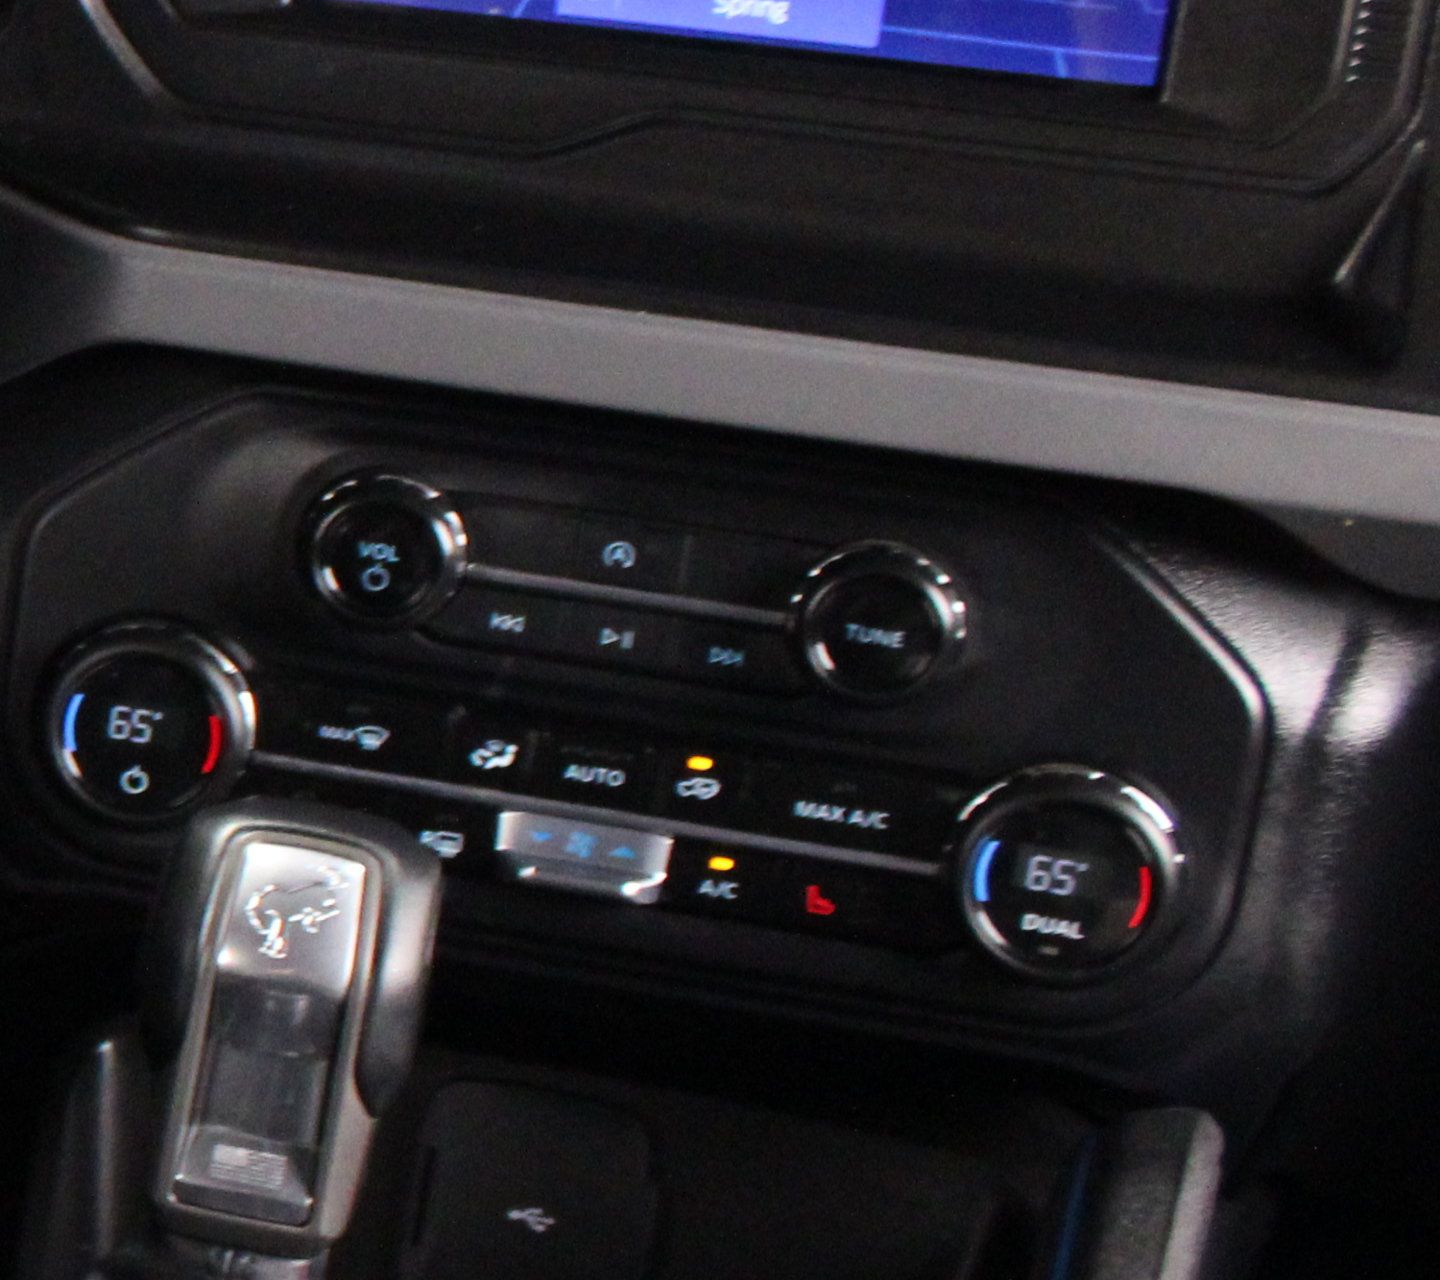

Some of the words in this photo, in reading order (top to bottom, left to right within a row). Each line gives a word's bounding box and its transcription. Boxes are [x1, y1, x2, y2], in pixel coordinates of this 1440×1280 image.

[358, 541, 401, 563] VOL
[844, 622, 907, 649] TUNE
[562, 763, 627, 788] AUTO
[792, 800, 847, 823] MAX
[848, 808, 890, 830] A/C
[697, 879, 740, 900] A/C
[1021, 913, 1085, 941] DUAL
